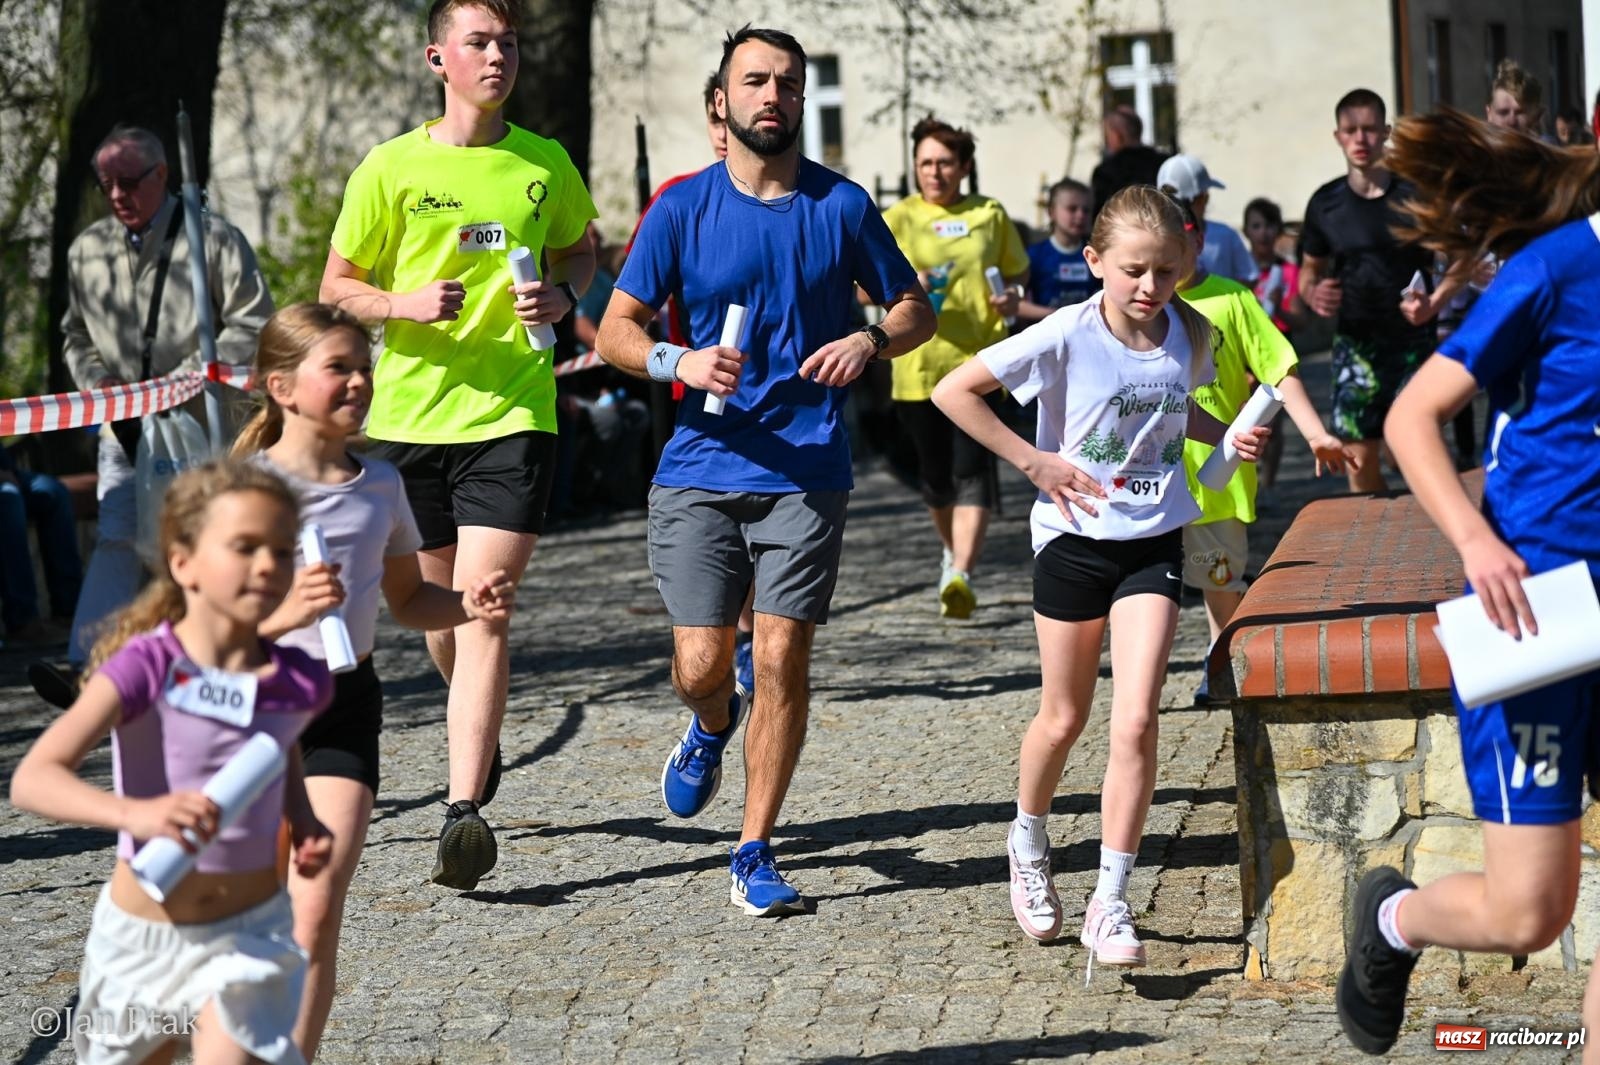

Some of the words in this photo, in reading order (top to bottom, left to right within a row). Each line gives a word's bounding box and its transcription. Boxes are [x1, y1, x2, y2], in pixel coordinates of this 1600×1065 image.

[475, 230, 502, 244] 007
[1131, 480, 1160, 496] 091
[1510, 723, 1562, 789] 75
